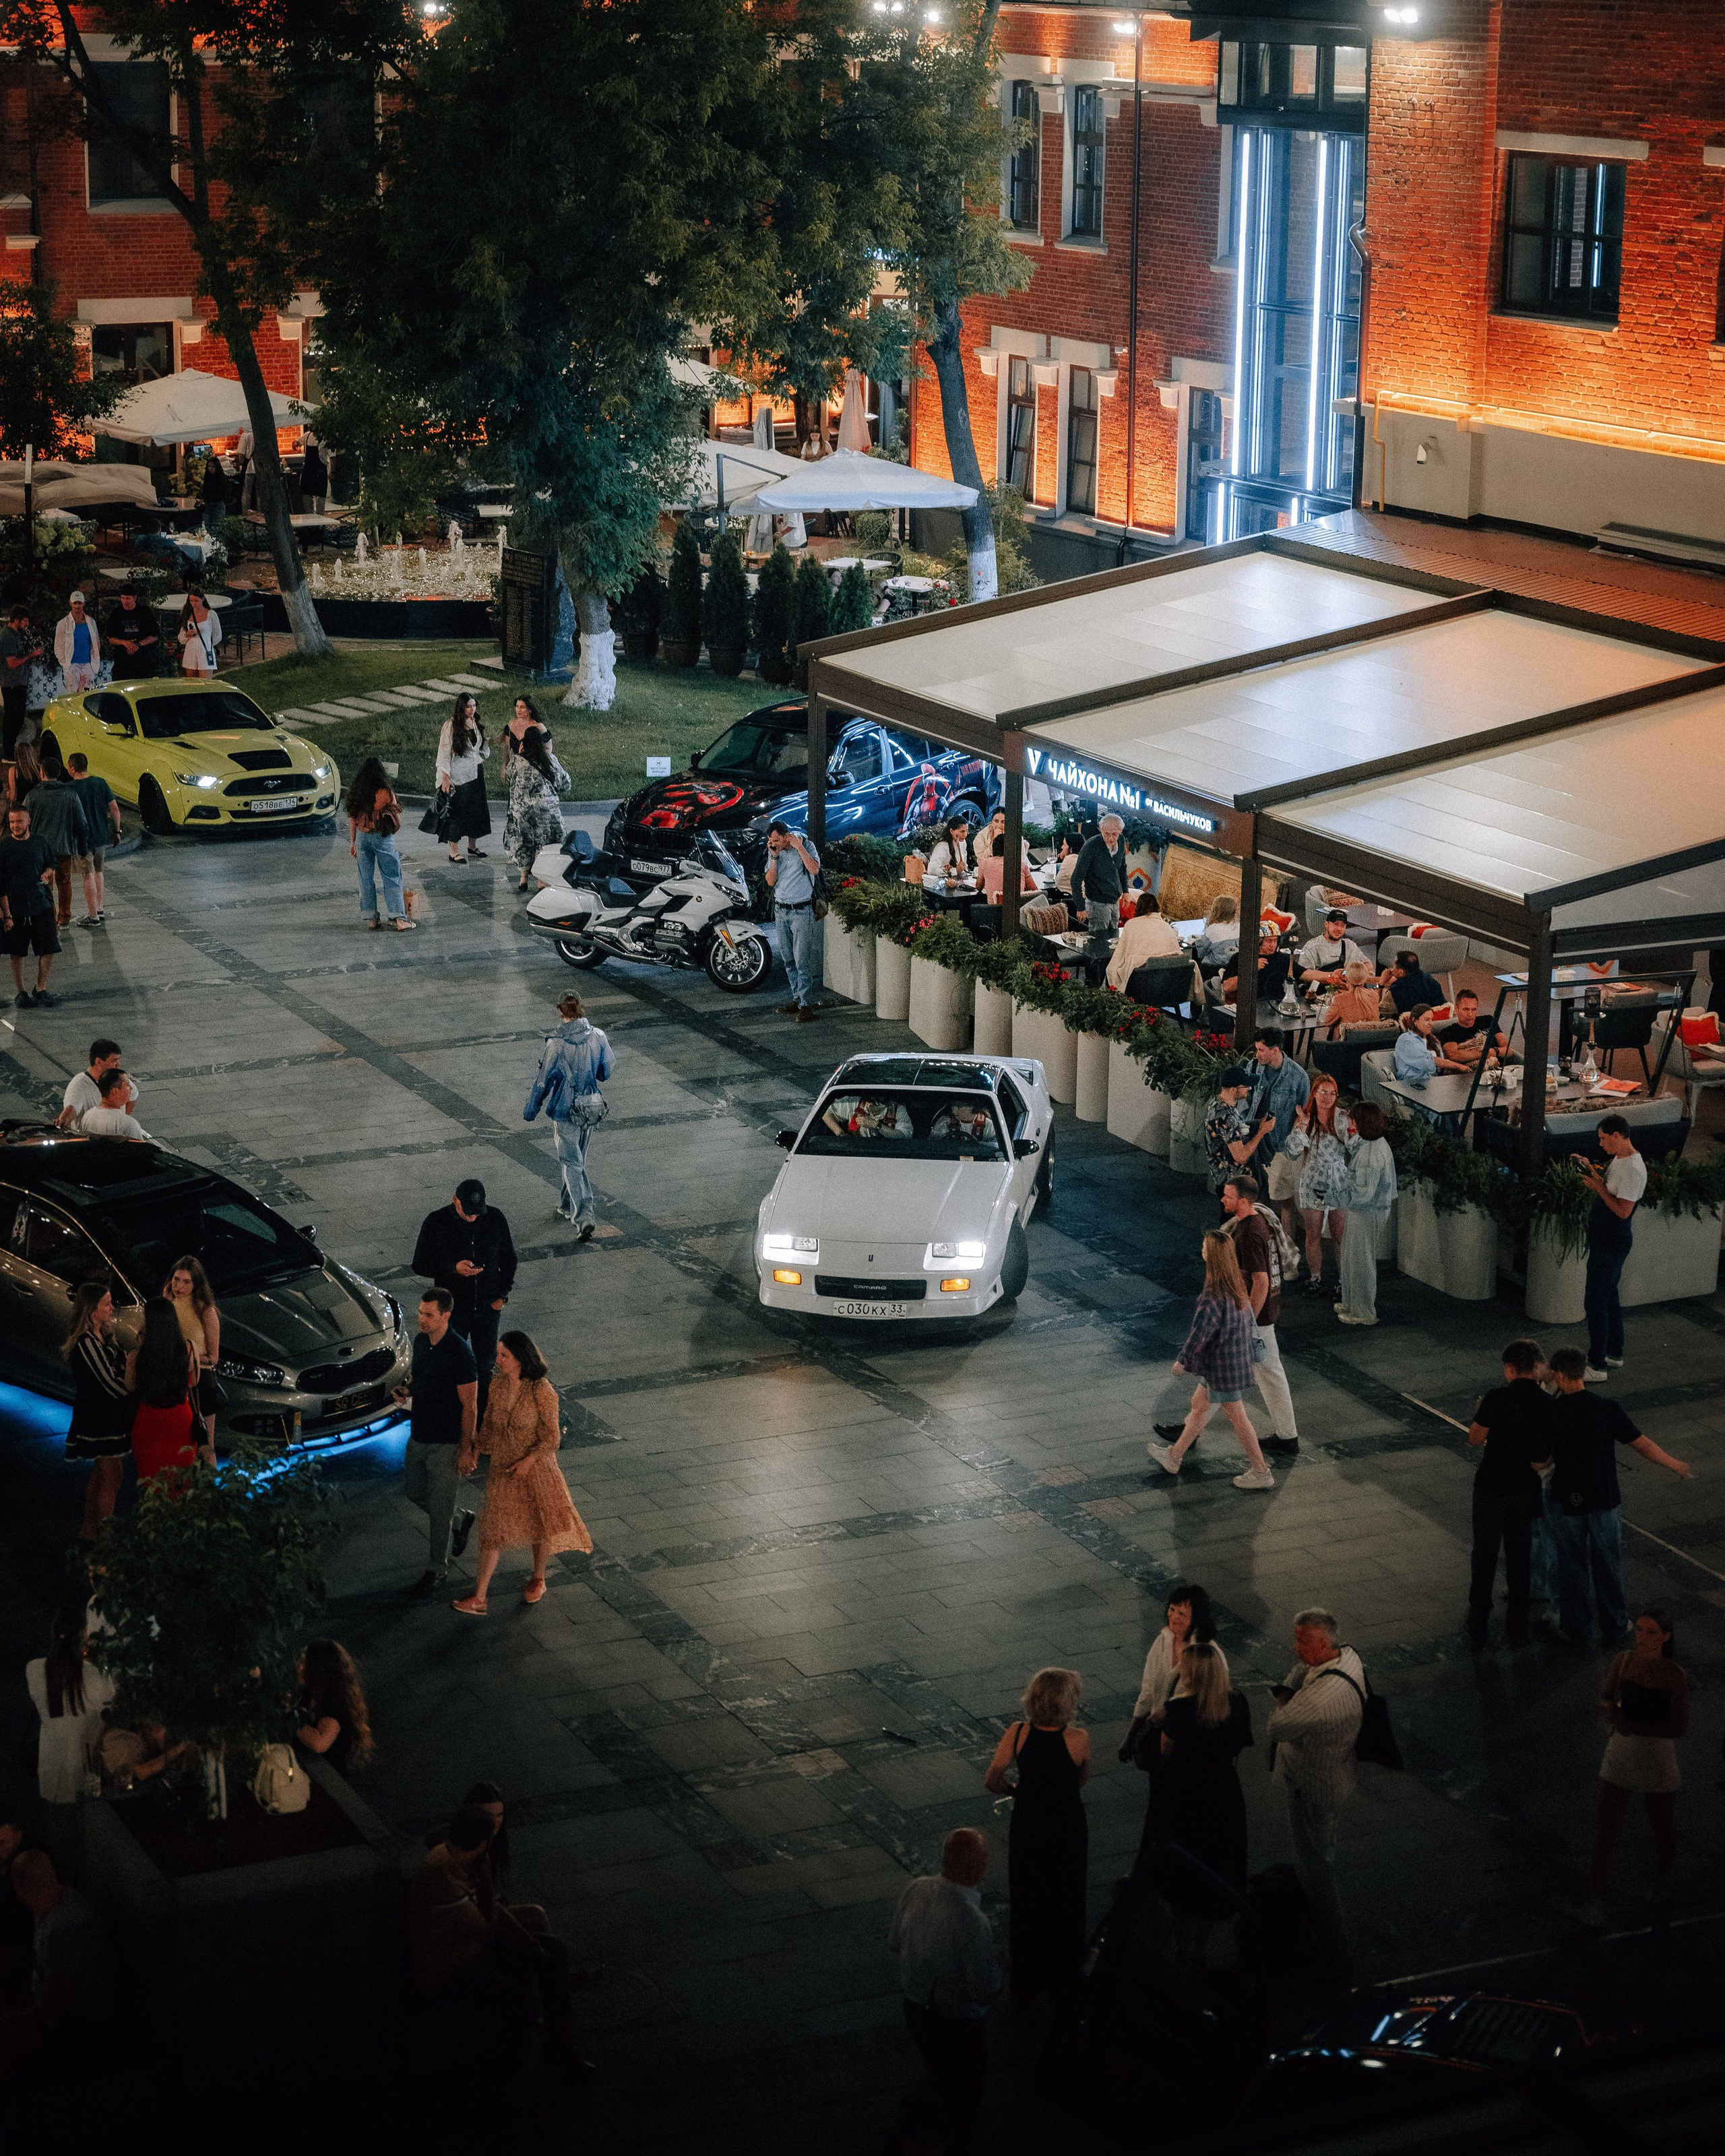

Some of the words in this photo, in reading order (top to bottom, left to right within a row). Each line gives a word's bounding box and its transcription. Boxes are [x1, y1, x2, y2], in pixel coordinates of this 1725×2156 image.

[1048, 758, 1119, 802] ЧАЙХОНА
[1154, 800, 1212, 831] ВАСИЛЬЧУКОВ
[890, 1304, 902, 1313] 33
